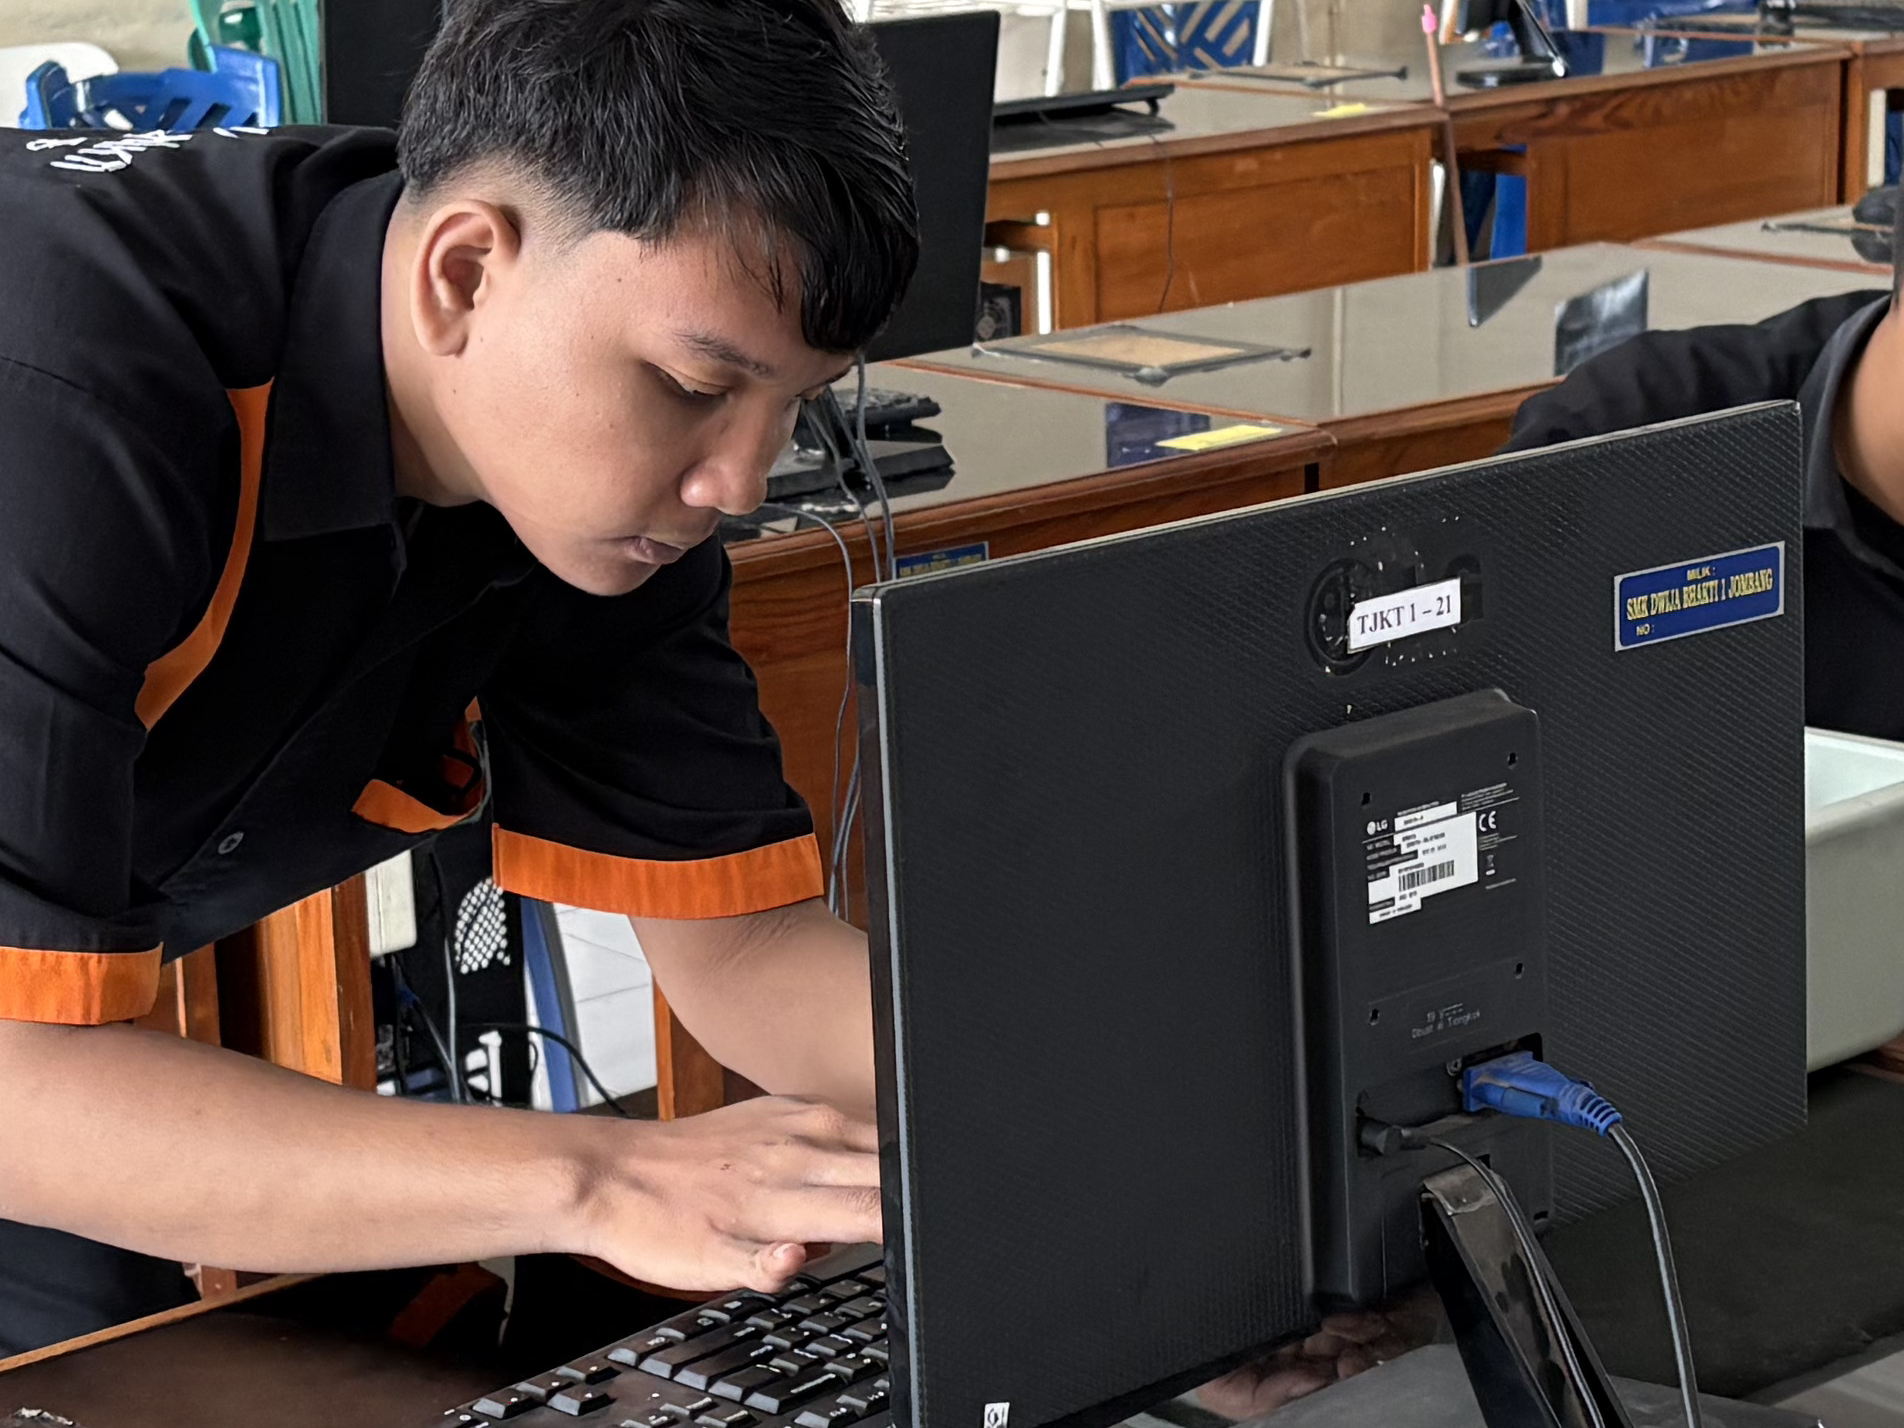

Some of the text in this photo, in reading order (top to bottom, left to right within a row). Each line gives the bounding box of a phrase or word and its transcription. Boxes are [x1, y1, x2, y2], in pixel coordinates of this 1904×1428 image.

[1728, 568, 1773, 598] JOMBANG
[1357, 606, 1405, 635] TJKT
[1410, 603, 1416, 622] 1
[1436, 594, 1452, 616] 21
